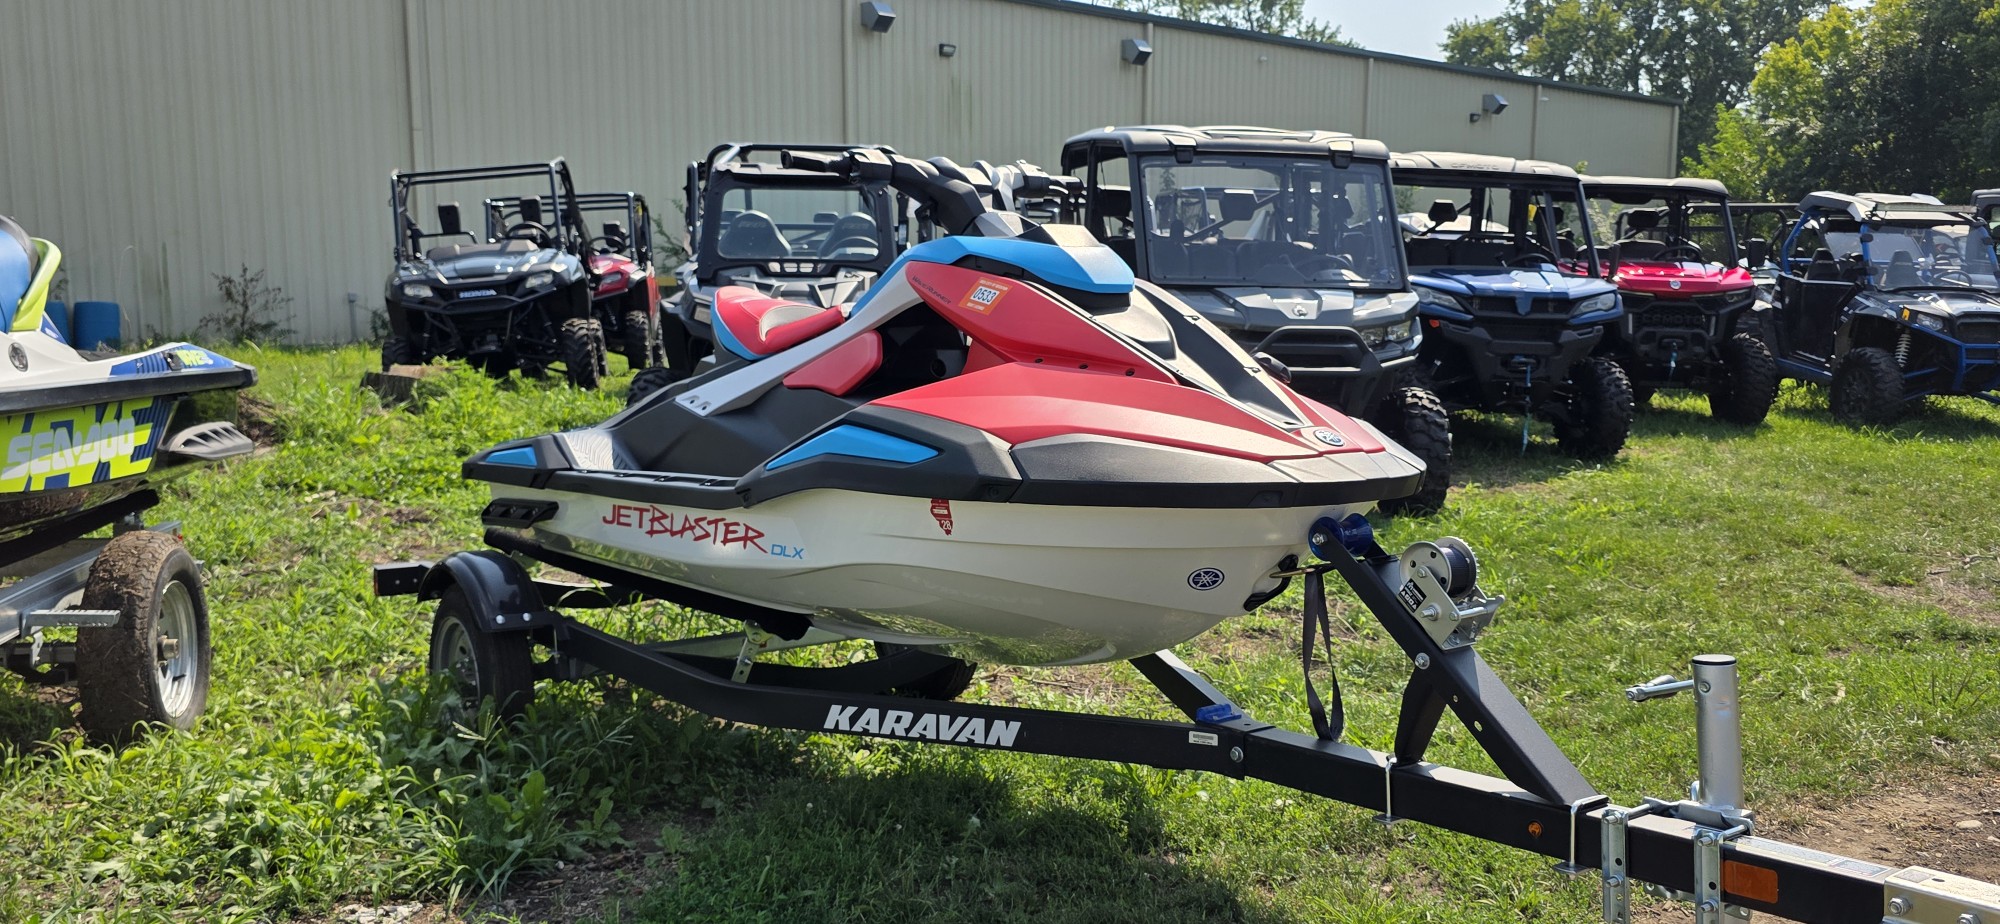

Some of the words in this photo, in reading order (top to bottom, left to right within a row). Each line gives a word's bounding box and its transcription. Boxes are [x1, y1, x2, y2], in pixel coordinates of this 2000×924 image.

[459, 289, 497, 298] HONDA
[973, 288, 997, 303] 0533
[770, 544, 804, 559] DLX
[824, 704, 1021, 747] KARAVAN
